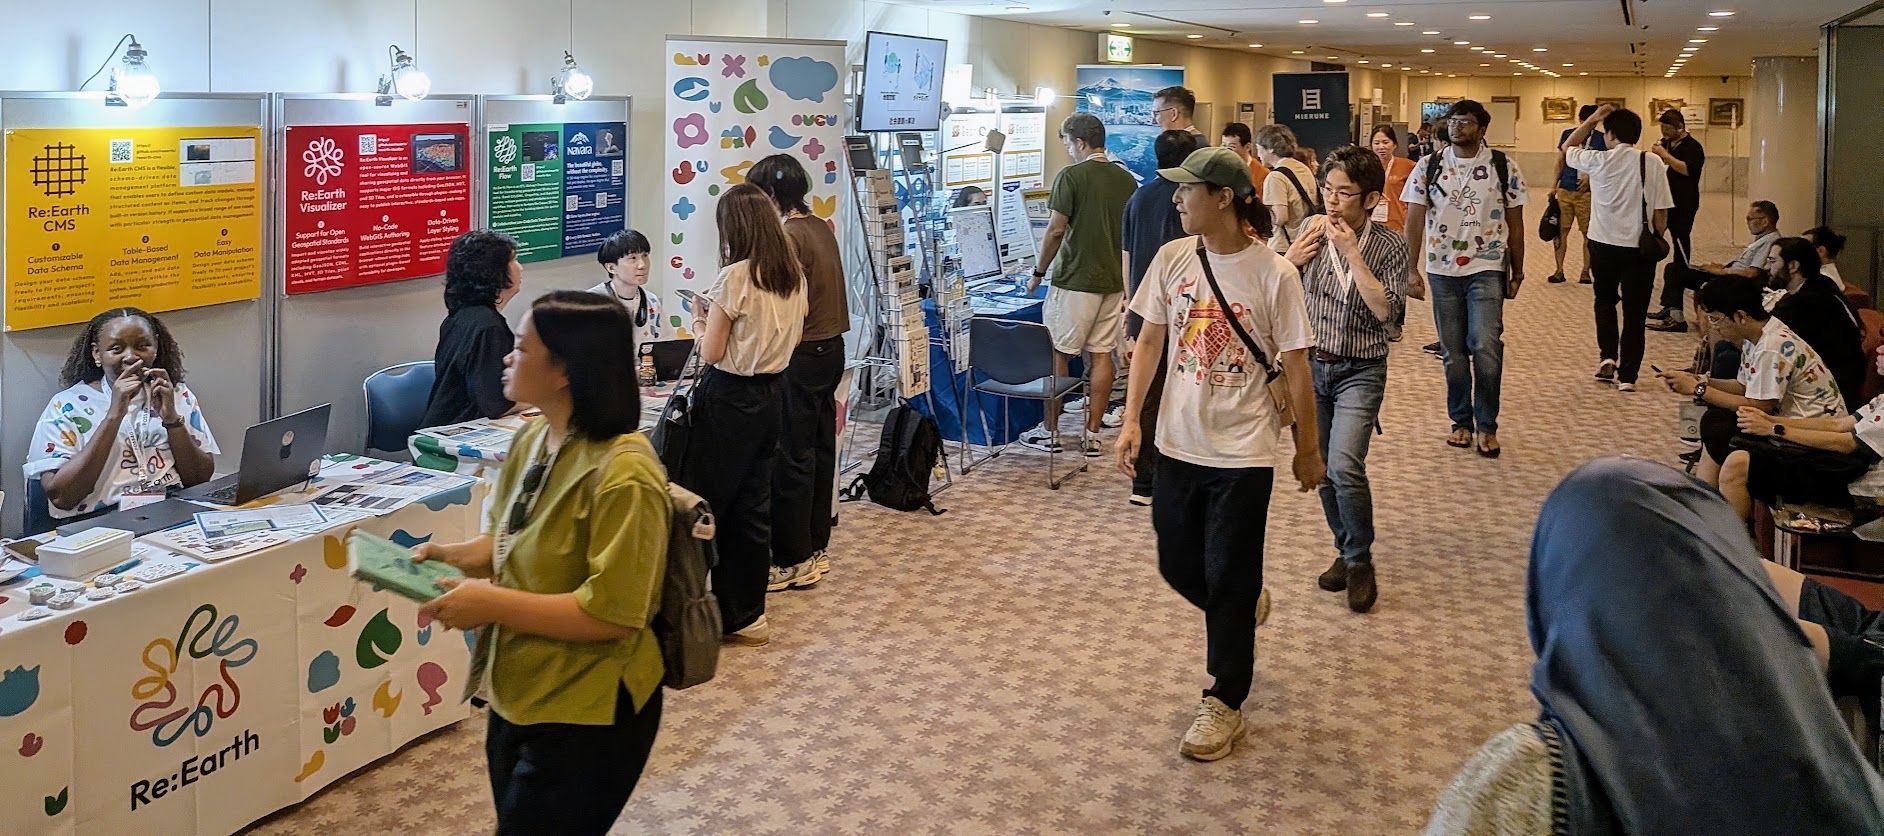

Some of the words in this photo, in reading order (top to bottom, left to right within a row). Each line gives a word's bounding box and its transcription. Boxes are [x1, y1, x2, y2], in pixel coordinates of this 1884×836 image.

[493, 165, 517, 173] Re:Earth
[302, 188, 345, 201] Re:Earth
[29, 204, 89, 218] Re:Earth
[300, 200, 347, 212] Visualizer
[44, 219, 75, 231] CMS
[372, 223, 398, 231] No-Code
[296, 231, 319, 239] Support
[320, 230, 329, 238] for
[427, 227, 442, 235] Layer
[292, 240, 321, 248] Geospatial
[322, 237, 349, 245] Standards
[360, 233, 383, 241] WebGIS
[123, 245, 168, 255] Table-Based
[194, 250, 211, 258] Data
[213, 246, 253, 255] Manipulation
[28, 253, 83, 264] Customizable
[132, 253, 178, 264] Management
[131, 729, 259, 811] Re:Earth
